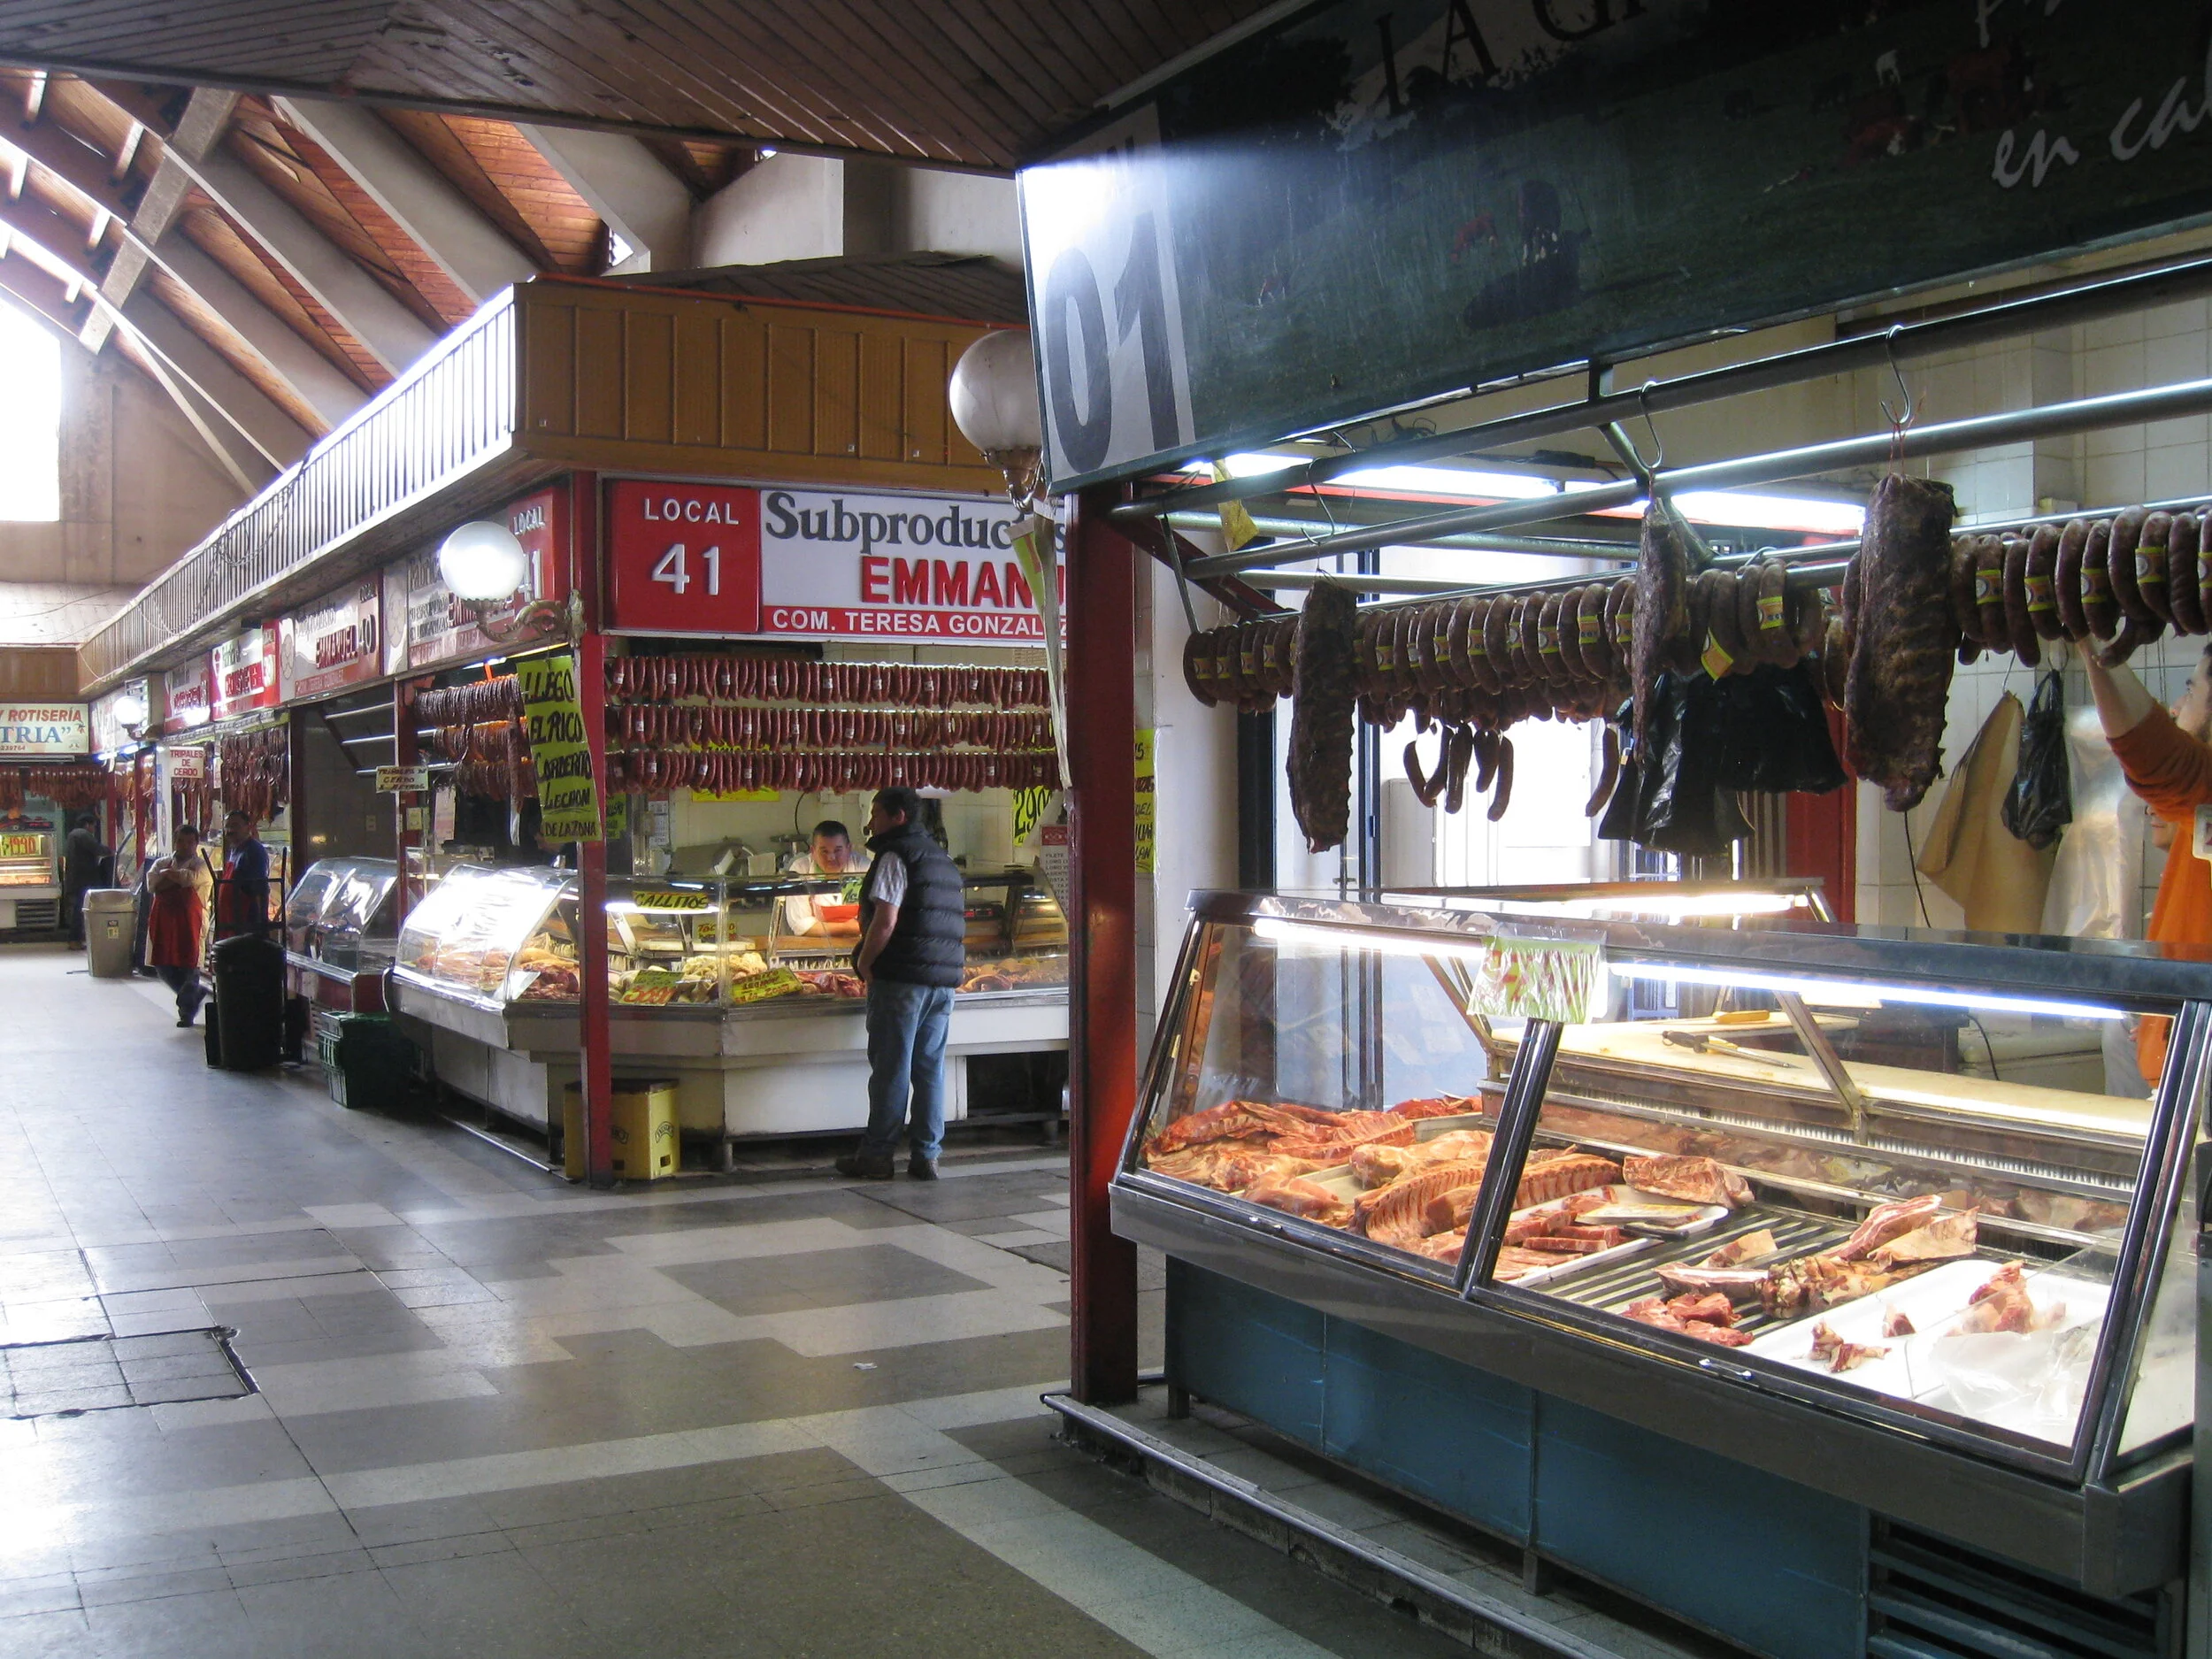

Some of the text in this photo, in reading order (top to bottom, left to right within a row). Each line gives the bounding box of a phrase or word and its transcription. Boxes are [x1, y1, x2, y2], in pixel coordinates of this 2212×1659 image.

[2108, 32, 2212, 161] ca
[1045, 211, 1180, 475] 01
[513, 506, 545, 535] LOCAL
[644, 498, 740, 525] LOCAL
[764, 491, 1065, 555] Subproducs
[651, 542, 720, 596] 41
[861, 555, 1065, 610] EMMAN
[772, 608, 1067, 636] COM. TERESA GONZAL
[316, 625, 358, 670] EMMANUEL
[530, 710, 584, 745] EL RICO
[170, 749, 204, 758] TRIPALES
[181, 758, 191, 767] DE
[173, 767, 198, 776] CERDO
[544, 781, 591, 810] LECHON
[544, 820, 557, 837] DE
[569, 819, 597, 837] ZONA
